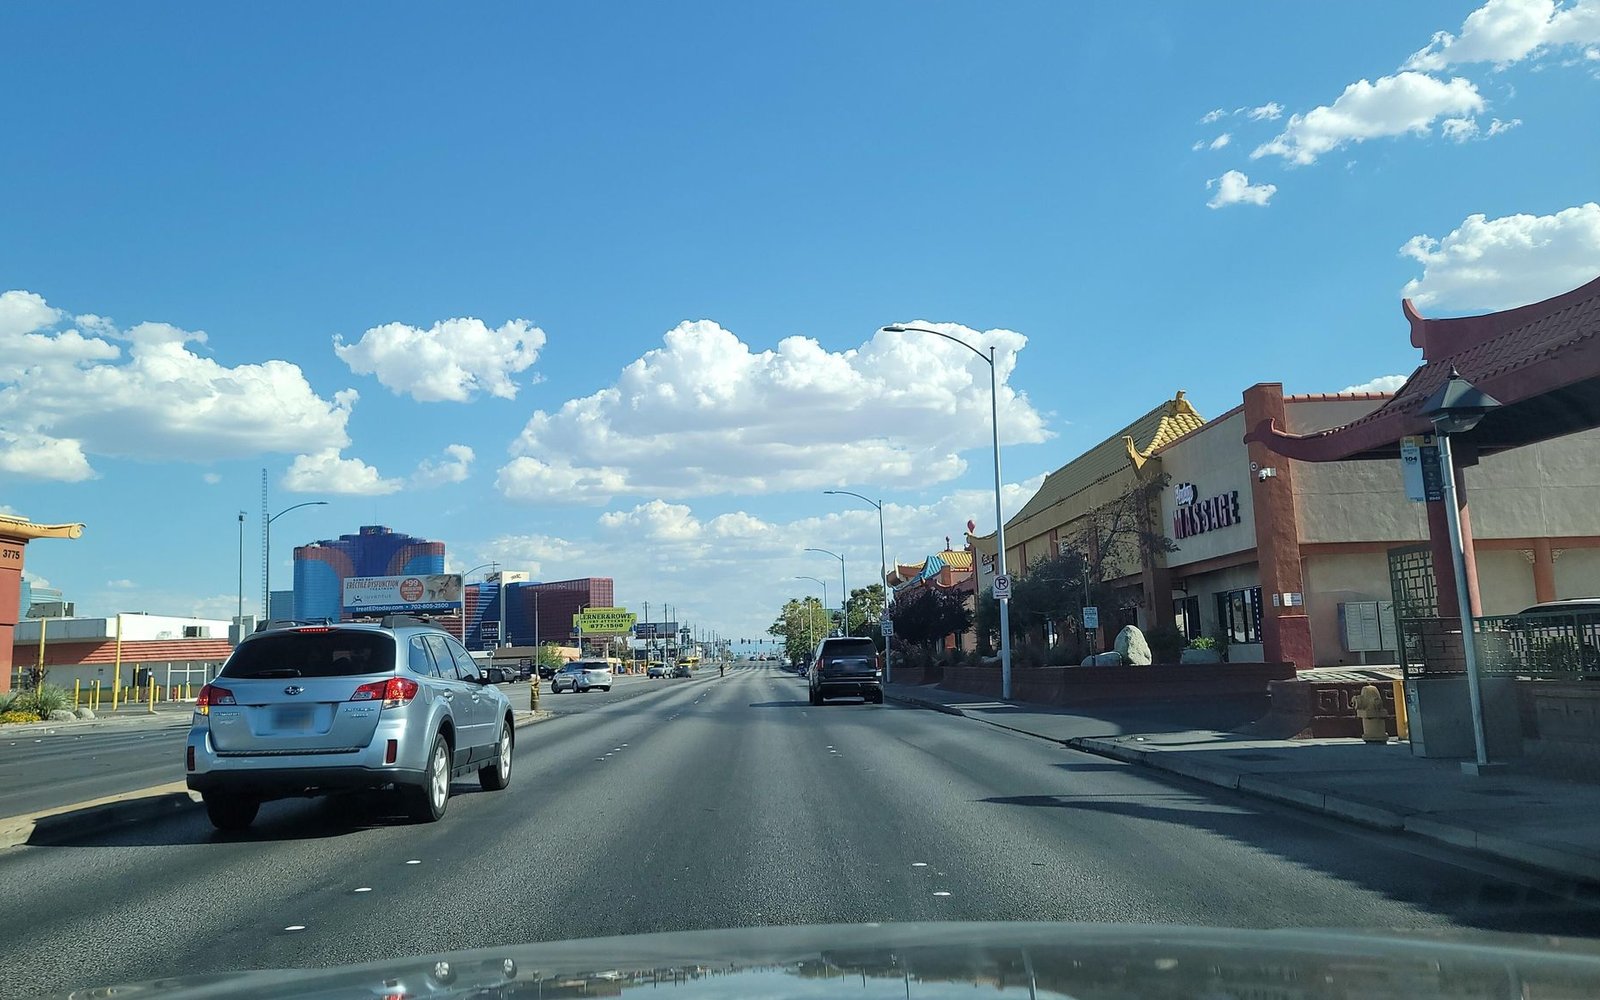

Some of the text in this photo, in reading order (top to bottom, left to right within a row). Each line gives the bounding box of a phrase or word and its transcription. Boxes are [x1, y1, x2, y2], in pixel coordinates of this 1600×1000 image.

[1173, 491, 1240, 539] MASSAGE
[2, 549, 20, 560] 3775
[346, 580, 399, 590] ERECTILE DYSFUNCTION
